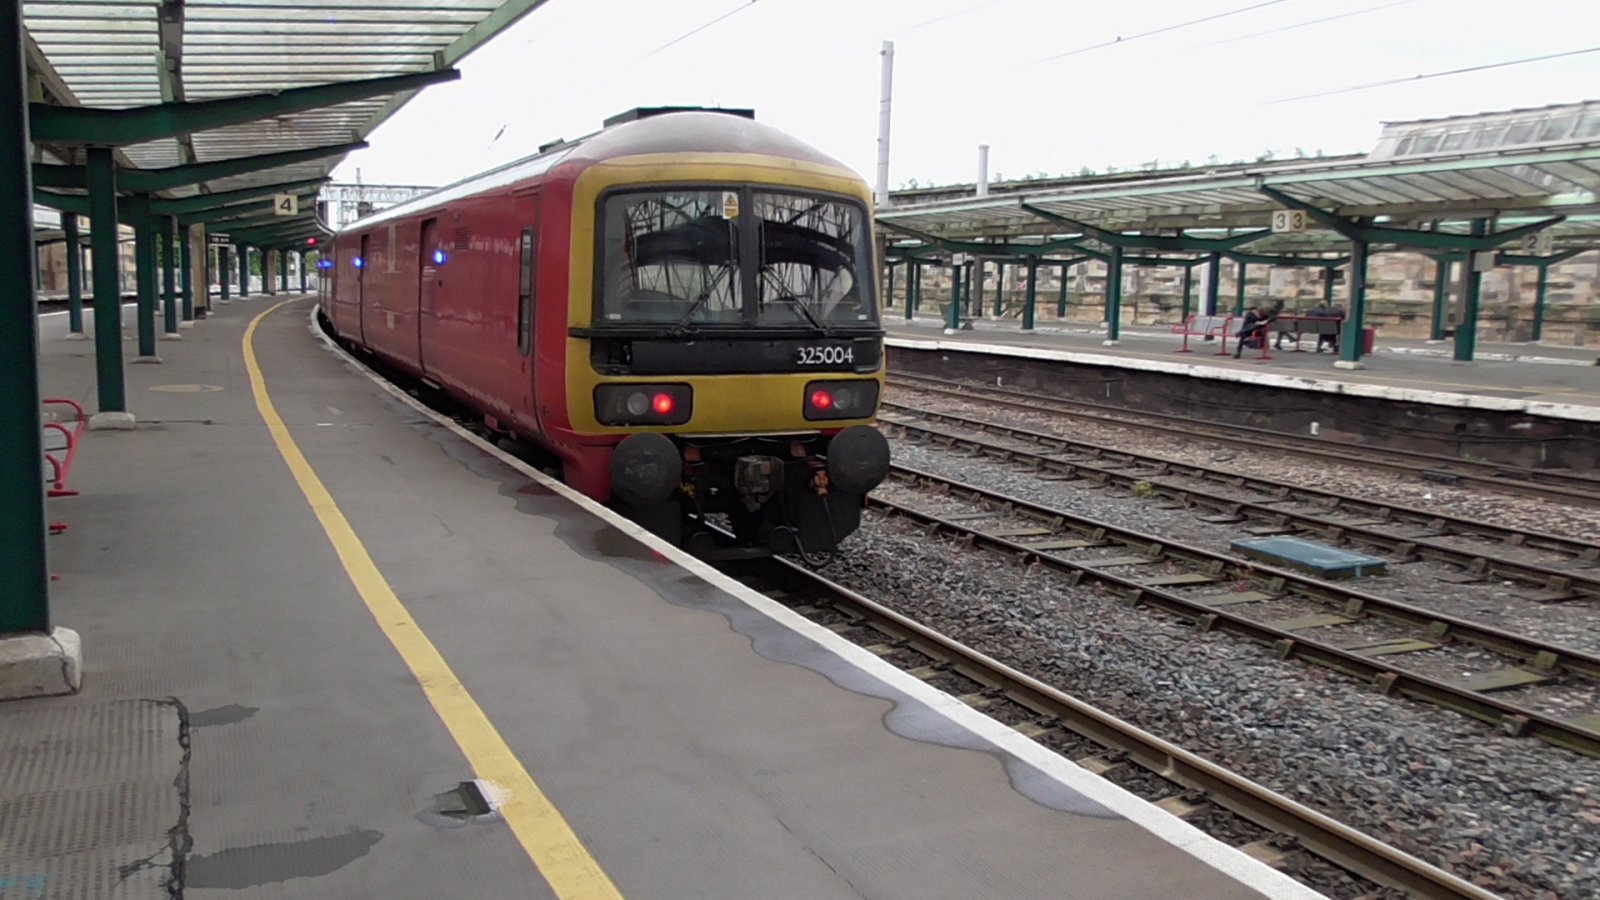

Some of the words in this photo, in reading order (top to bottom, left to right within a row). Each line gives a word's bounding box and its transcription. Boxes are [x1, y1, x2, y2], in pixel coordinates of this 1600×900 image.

[280, 198, 292, 212] 4
[1276, 213, 1286, 229] 3
[1292, 213, 1302, 229] 3
[1527, 235, 1538, 249] 2
[797, 346, 854, 365] 325004
